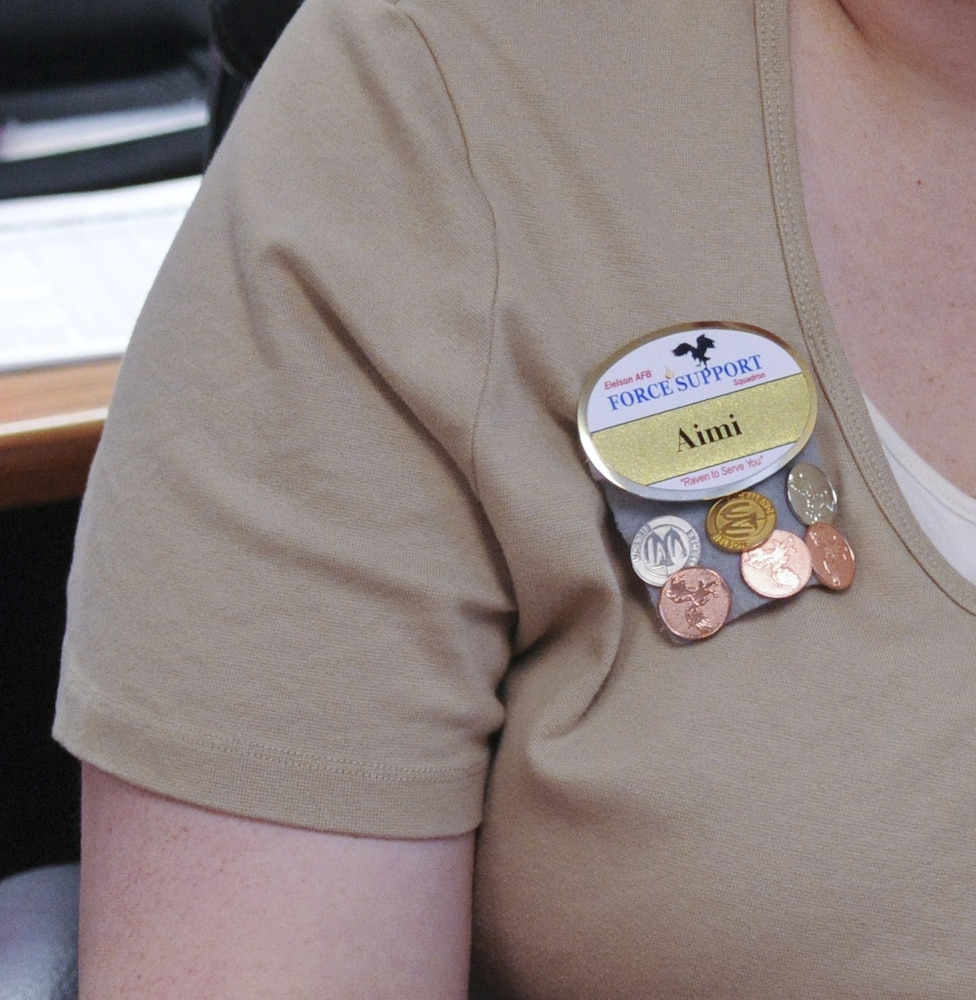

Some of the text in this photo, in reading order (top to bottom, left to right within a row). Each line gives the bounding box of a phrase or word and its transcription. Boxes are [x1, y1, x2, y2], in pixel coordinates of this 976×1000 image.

[603, 369, 653, 390] Eielson AFB
[607, 354, 763, 411] FORCE SUPPORT
[733, 372, 766, 387] Squadron
[677, 413, 743, 453] Aimi
[711, 470, 720, 479] to
[721, 463, 745, 476] Serve
